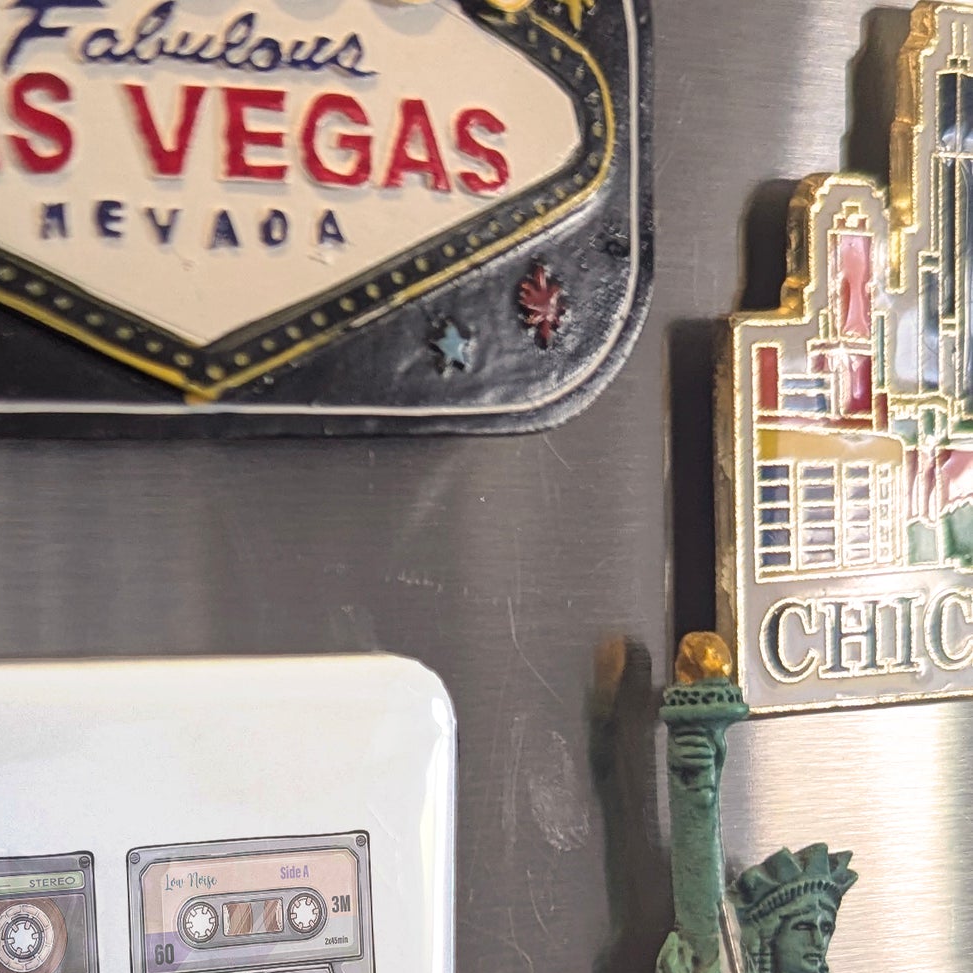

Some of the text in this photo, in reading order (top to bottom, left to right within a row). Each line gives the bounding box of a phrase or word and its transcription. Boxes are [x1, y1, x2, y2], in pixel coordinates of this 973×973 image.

[1, 0, 376, 77] Fabulous
[121, 84, 511, 196] VEGAS
[39, 202, 347, 251] NEVADA
[759, 588, 973, 682] CHIC
[29, 876, 76, 889] STEREO
[164, 871, 218, 891] Low Noise
[280, 865, 310, 880] Side A
[331, 895, 351, 913] 3M
[154, 943, 175, 966] 60
